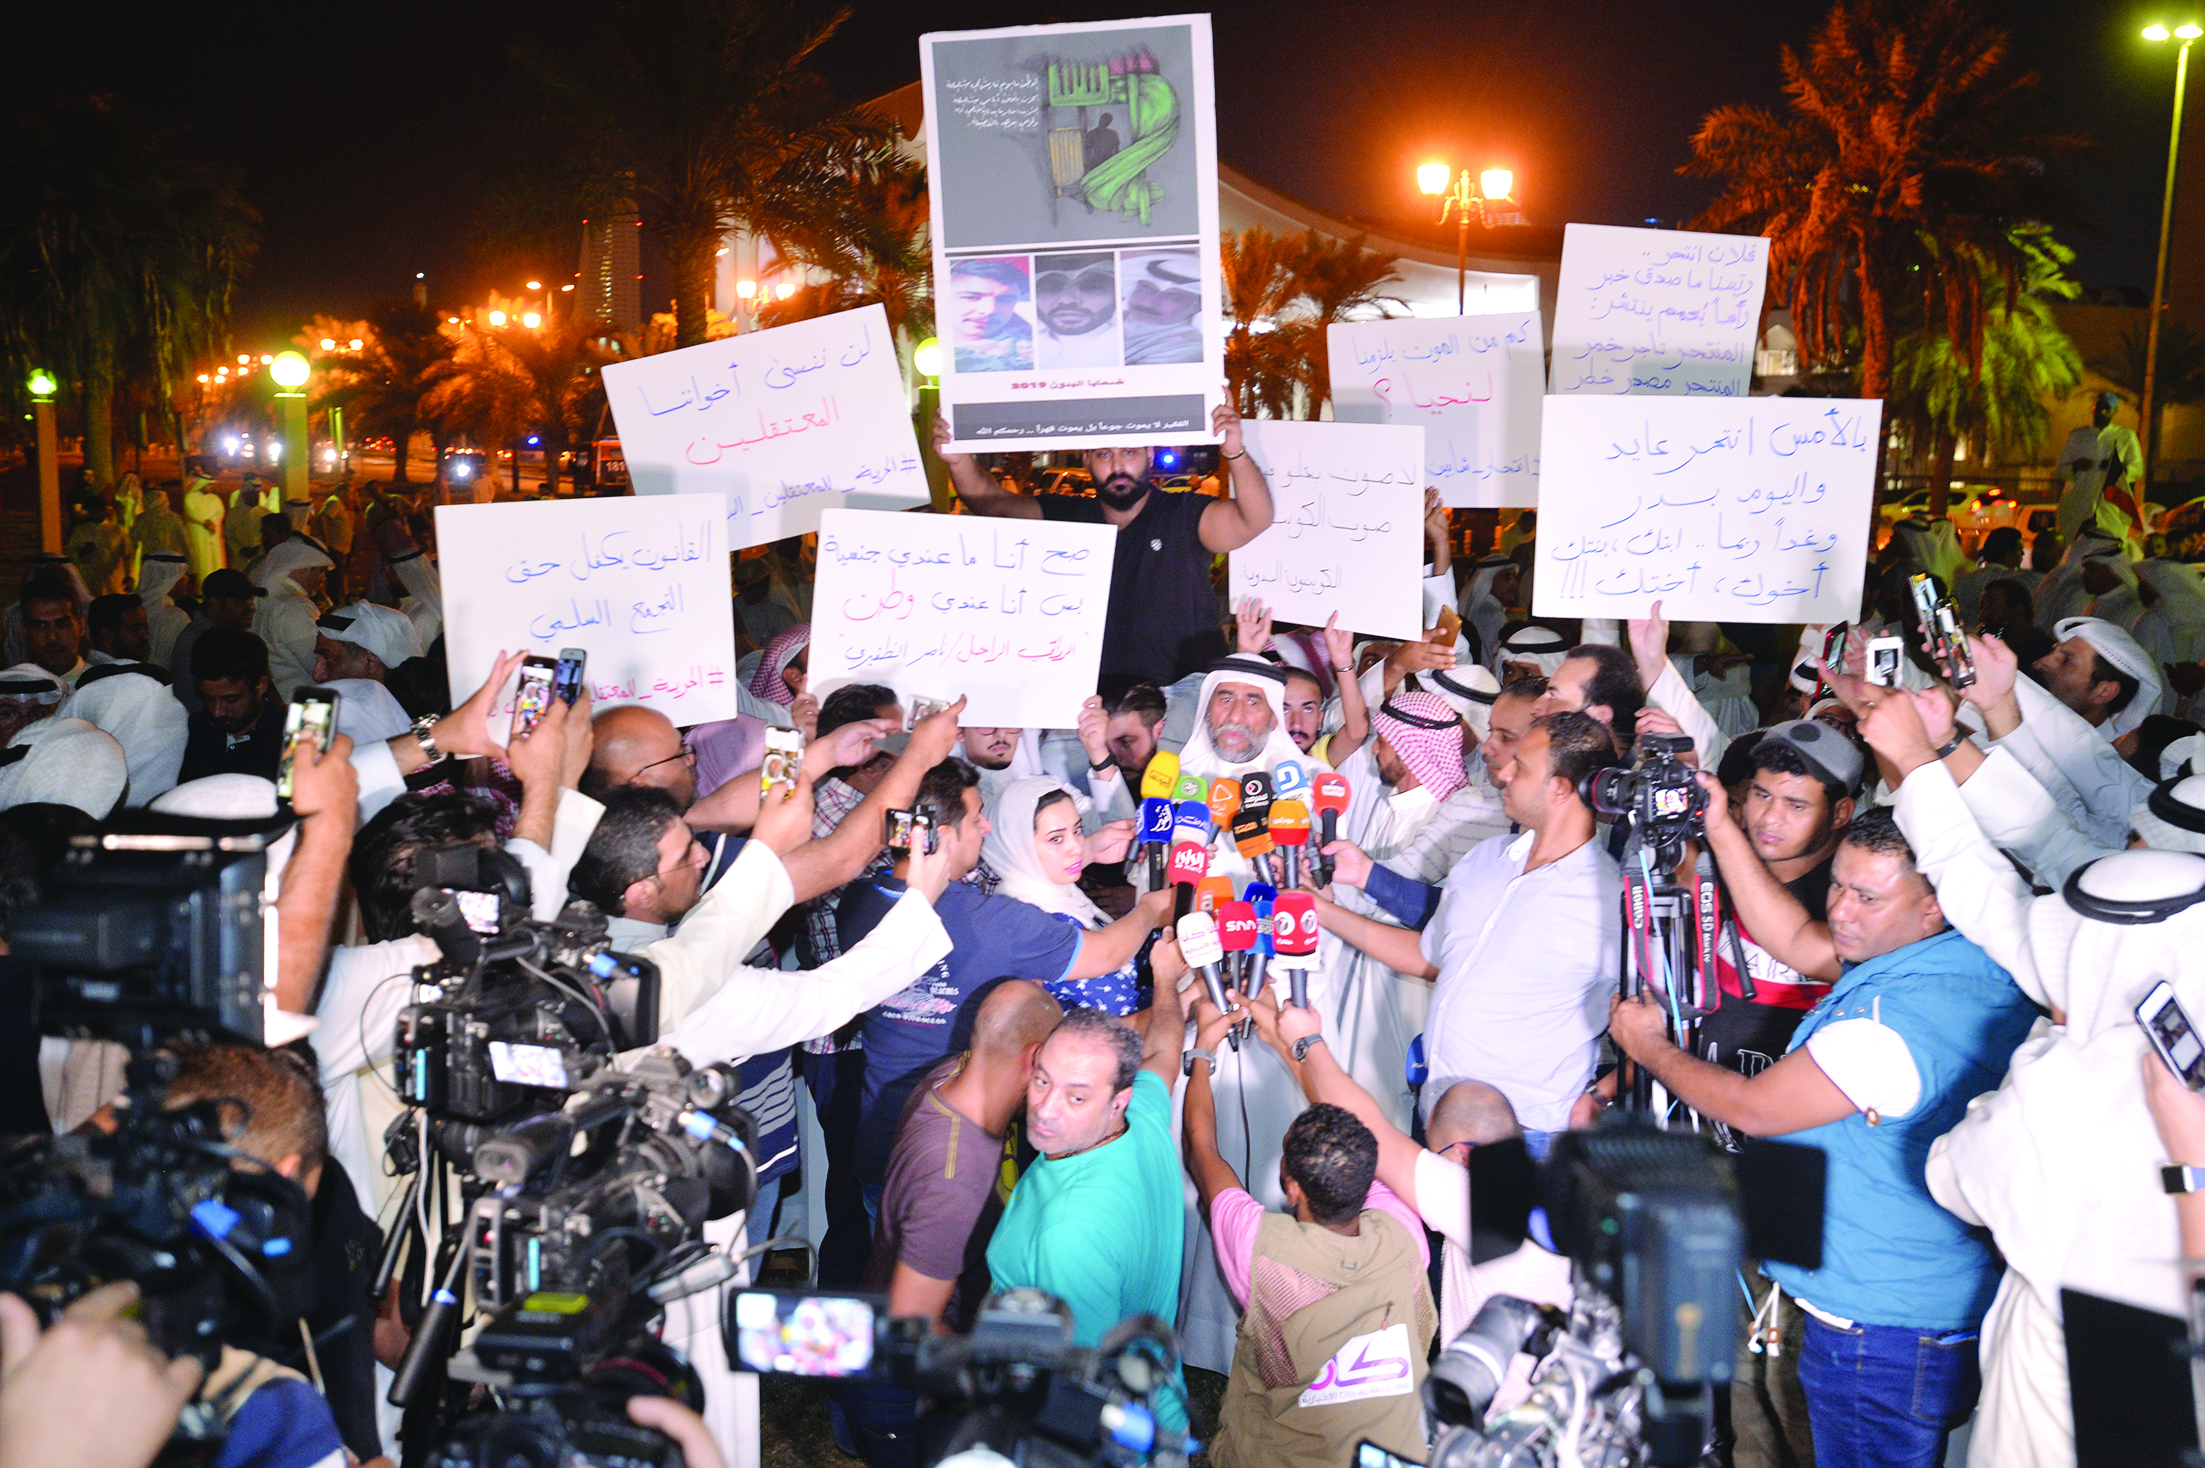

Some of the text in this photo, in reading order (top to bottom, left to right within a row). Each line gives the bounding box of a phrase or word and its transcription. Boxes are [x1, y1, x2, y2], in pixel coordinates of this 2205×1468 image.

[1687, 270, 1702, 288] ما
[840, 324, 871, 367] لن
[1011, 381, 1047, 390] 2019
[686, 394, 840, 465] المعتقلين
[1605, 408, 1868, 475] بالأمس انتحر عايد
[1328, 468, 1393, 496] صوت
[1397, 464, 1416, 485] لا
[1600, 472, 1826, 530] واليوم بدر
[1328, 516, 1391, 541] صوت
[506, 519, 712, 583] القانون يكفل حق
[823, 528, 1090, 576] صح أنا ما عندي جنسية
[842, 567, 1084, 621] بس أنا عندي وطن
[529, 598, 611, 643] السلمي
[1700, 882, 1714, 913] EOS
